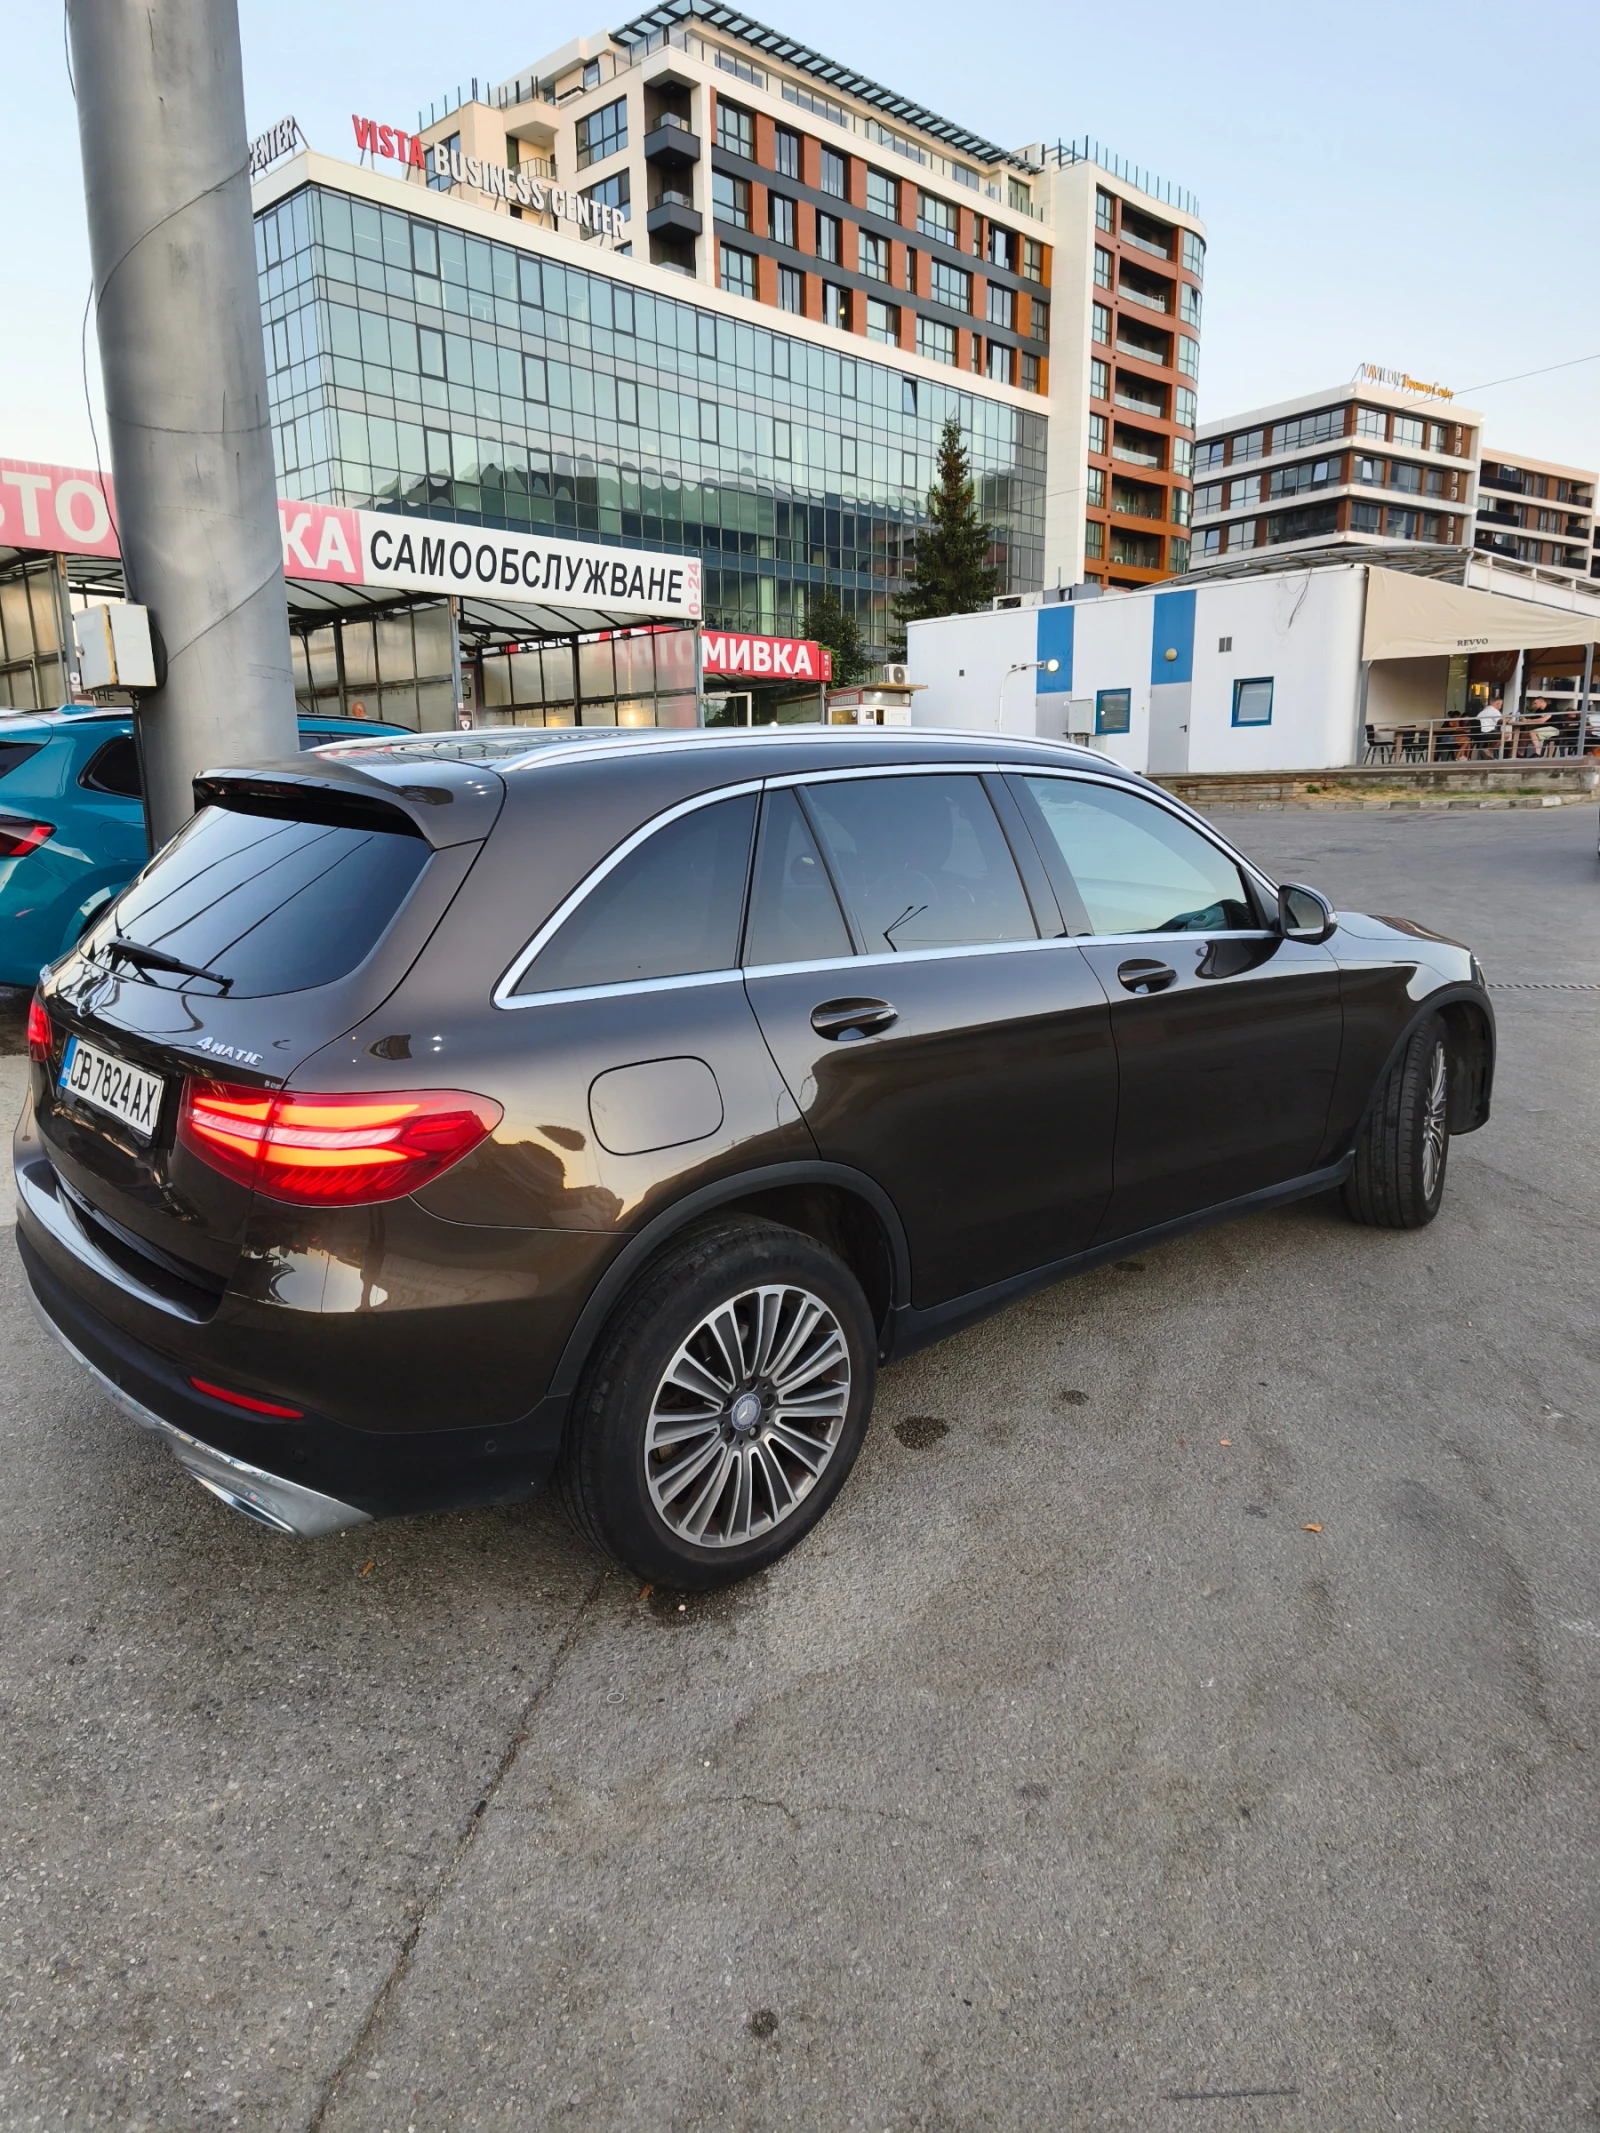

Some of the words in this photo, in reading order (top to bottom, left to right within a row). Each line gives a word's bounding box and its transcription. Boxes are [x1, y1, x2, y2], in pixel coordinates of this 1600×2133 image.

[352, 114, 426, 170] VISTA
[433, 142, 545, 210] BUSINESS
[551, 187, 626, 240] CENTER
[0, 470, 110, 544] ТО
[370, 529, 684, 604] САМООБСЛУЖВАНЕ
[1457, 638, 1488, 647] REVVO
